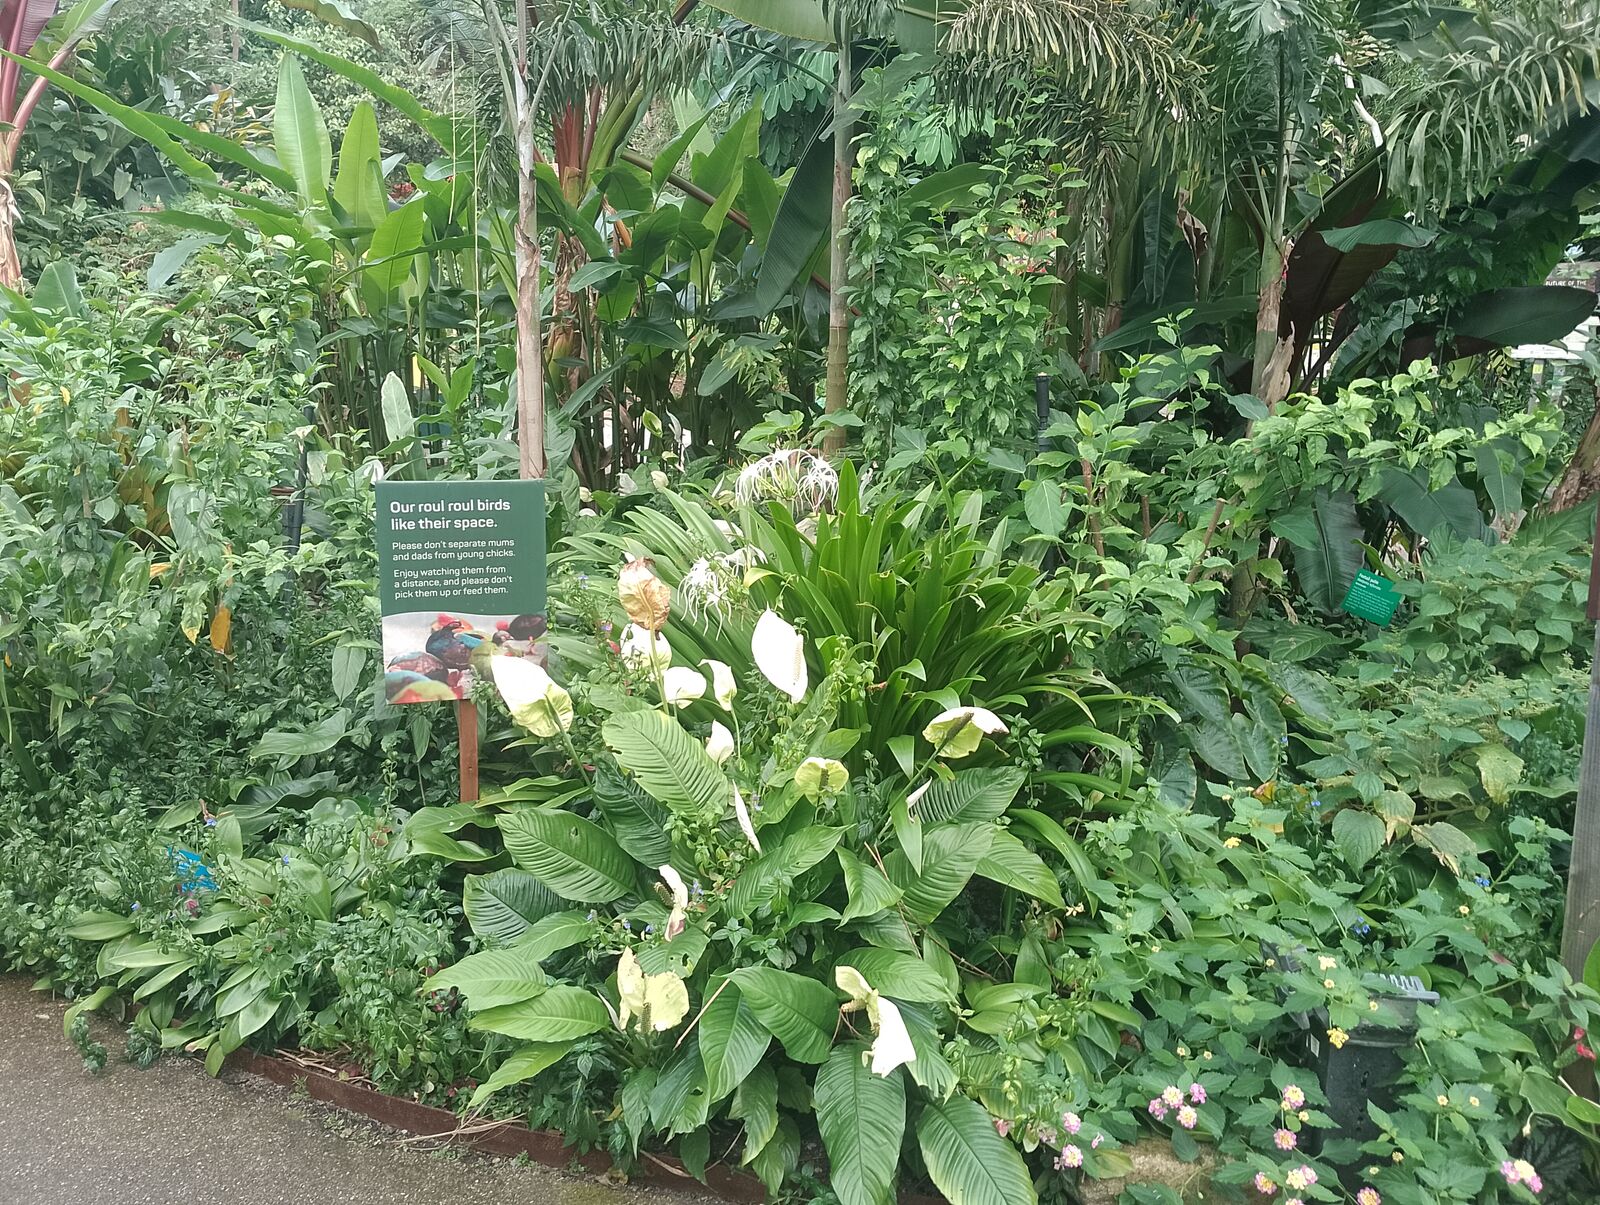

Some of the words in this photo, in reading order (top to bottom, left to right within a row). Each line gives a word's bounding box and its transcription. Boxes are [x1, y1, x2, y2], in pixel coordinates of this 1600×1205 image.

[390, 501, 415, 513] Our
[418, 500, 444, 512] roul
[448, 499, 474, 511] roul
[477, 499, 510, 511] birds
[391, 518, 416, 530] like
[418, 517, 451, 529] their
[454, 518, 497, 531] space.
[392, 542, 422, 550] Please
[424, 541, 446, 549] don't
[448, 540, 486, 549] separate
[411, 552, 432, 560] dads
[435, 551, 455, 559] from
[457, 551, 484, 560] young
[486, 549, 515, 557] chicks.
[394, 569, 418, 578] Enjoy
[420, 567, 460, 576] watching
[402, 579, 441, 588] distance,
[443, 577, 459, 585] and
[461, 577, 489, 586] please
[395, 590, 413, 600] pick
[440, 589, 451, 597] up
[463, 587, 482, 595] feed
[484, 586, 508, 594] them.
